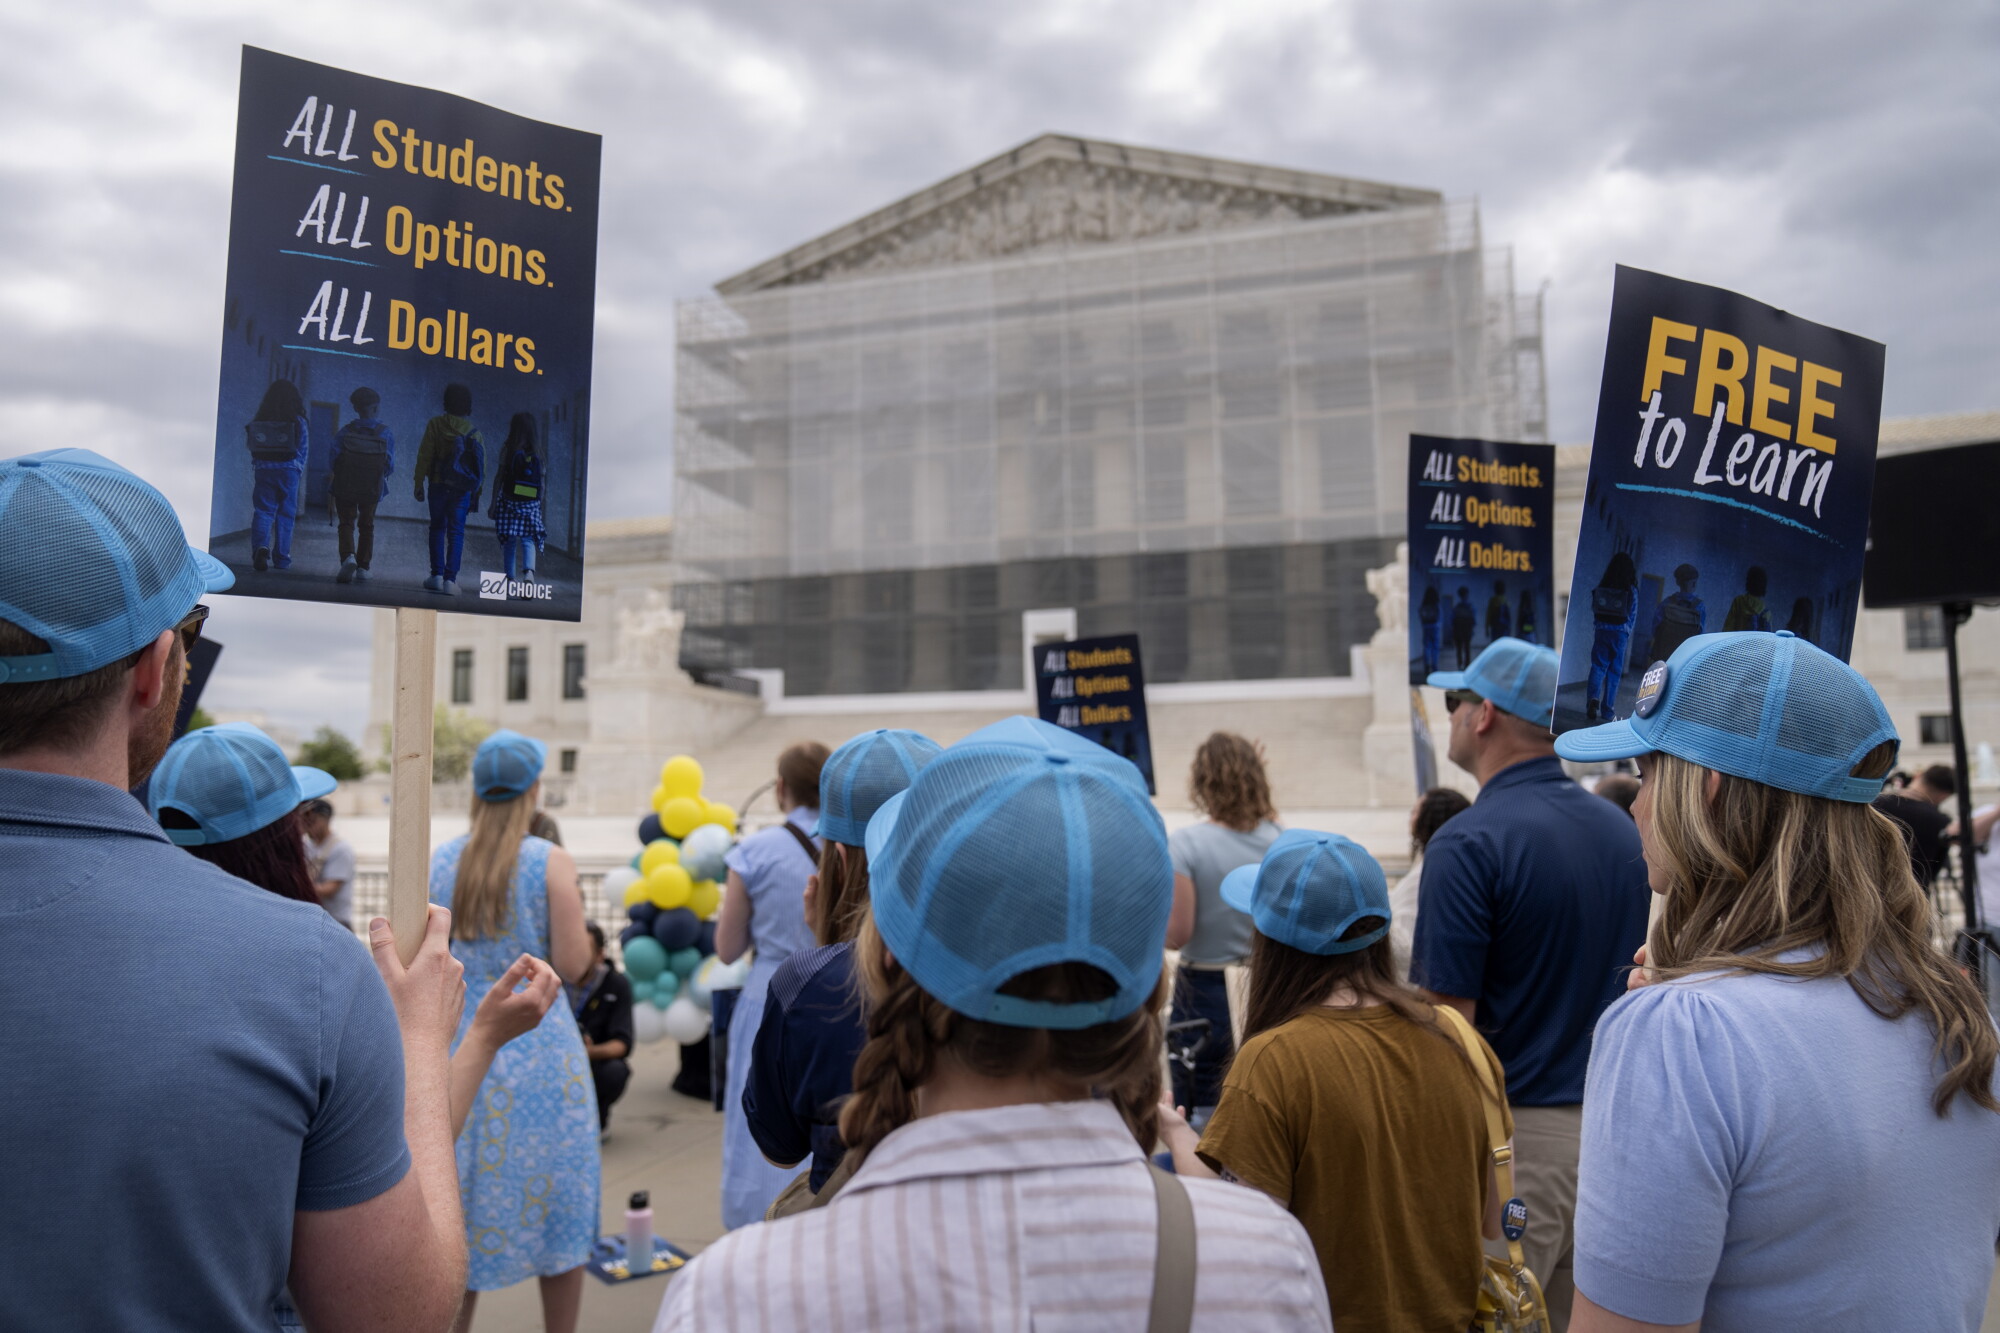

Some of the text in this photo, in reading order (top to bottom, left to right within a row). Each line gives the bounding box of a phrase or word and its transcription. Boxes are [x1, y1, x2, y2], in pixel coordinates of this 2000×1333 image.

[283, 95, 573, 213] ALL Students.
[295, 184, 554, 288] ALL Options.
[298, 280, 544, 375] ALL Dollars.
[1641, 316, 1843, 455] FREE
[1423, 450, 1544, 488] ALL Students.
[1633, 391, 1834, 519] to Learn
[1430, 491, 1536, 528] ALL Options.
[1434, 536, 1534, 572] ALL Dollars.
[1043, 650, 1068, 673] ALL
[1640, 667, 1664, 688] FREE
[1050, 676, 1075, 698] ALL
[1508, 1203, 1527, 1220] FREE
